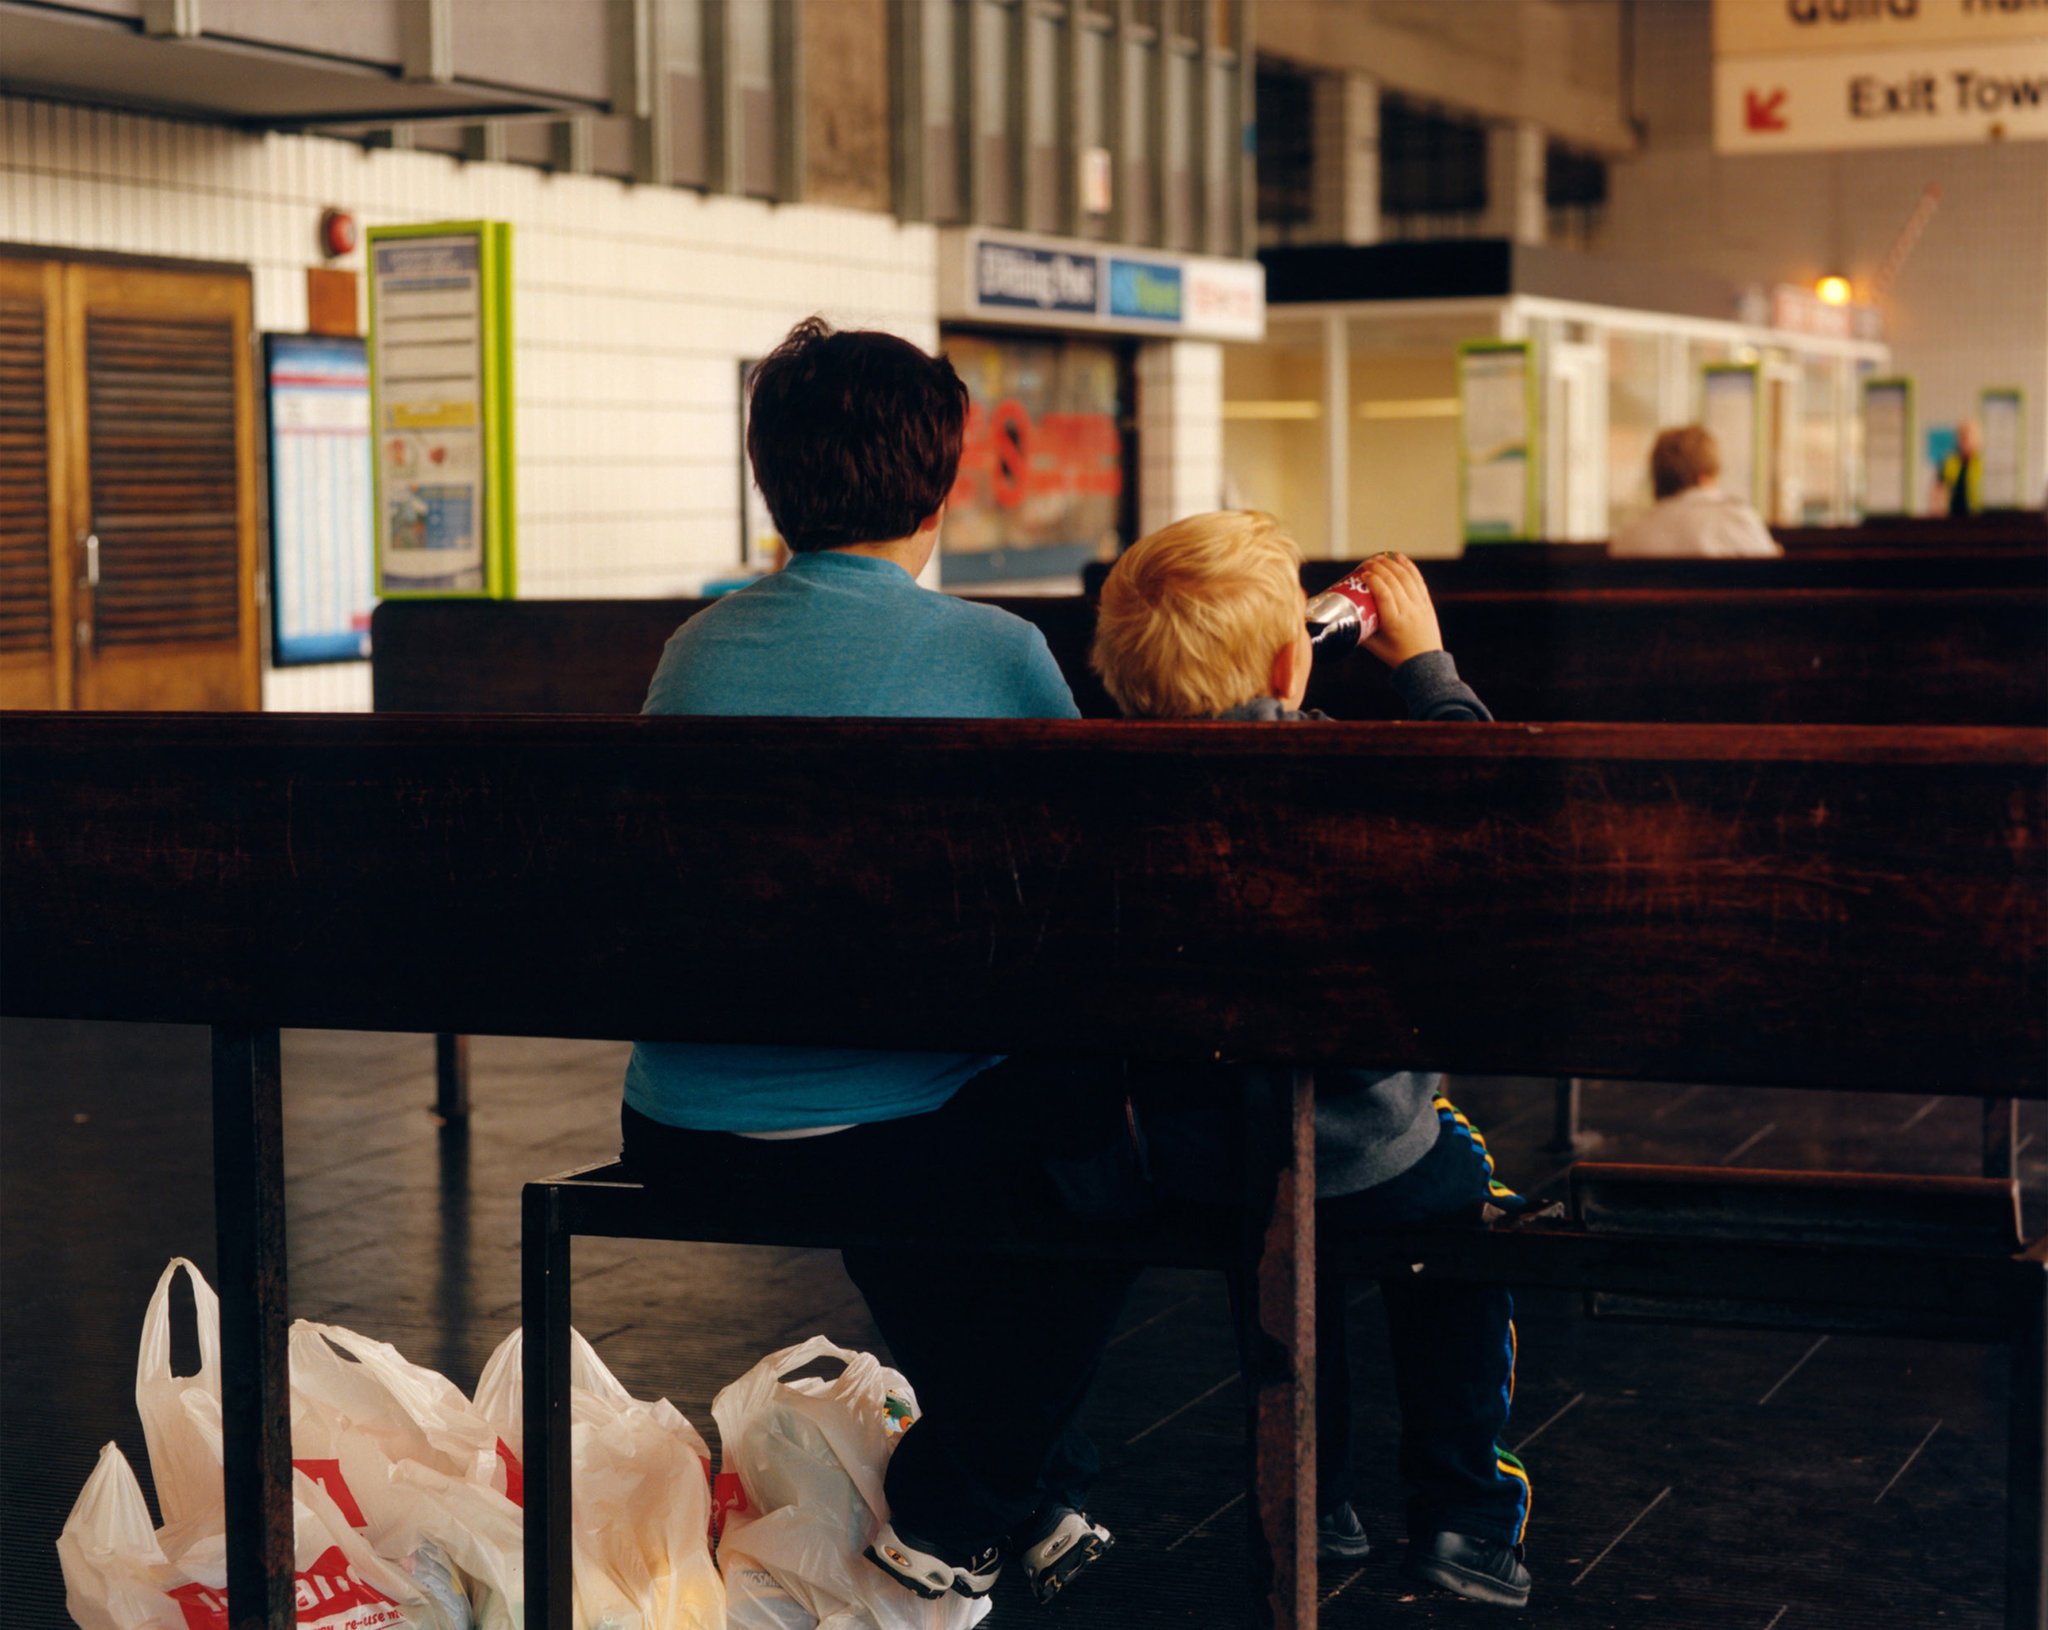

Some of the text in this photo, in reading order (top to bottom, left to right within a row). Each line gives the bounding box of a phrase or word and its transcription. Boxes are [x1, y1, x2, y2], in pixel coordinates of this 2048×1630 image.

[1848, 69, 2048, 119] Exit Tow
[345, 1610, 386, 1630] re-use
